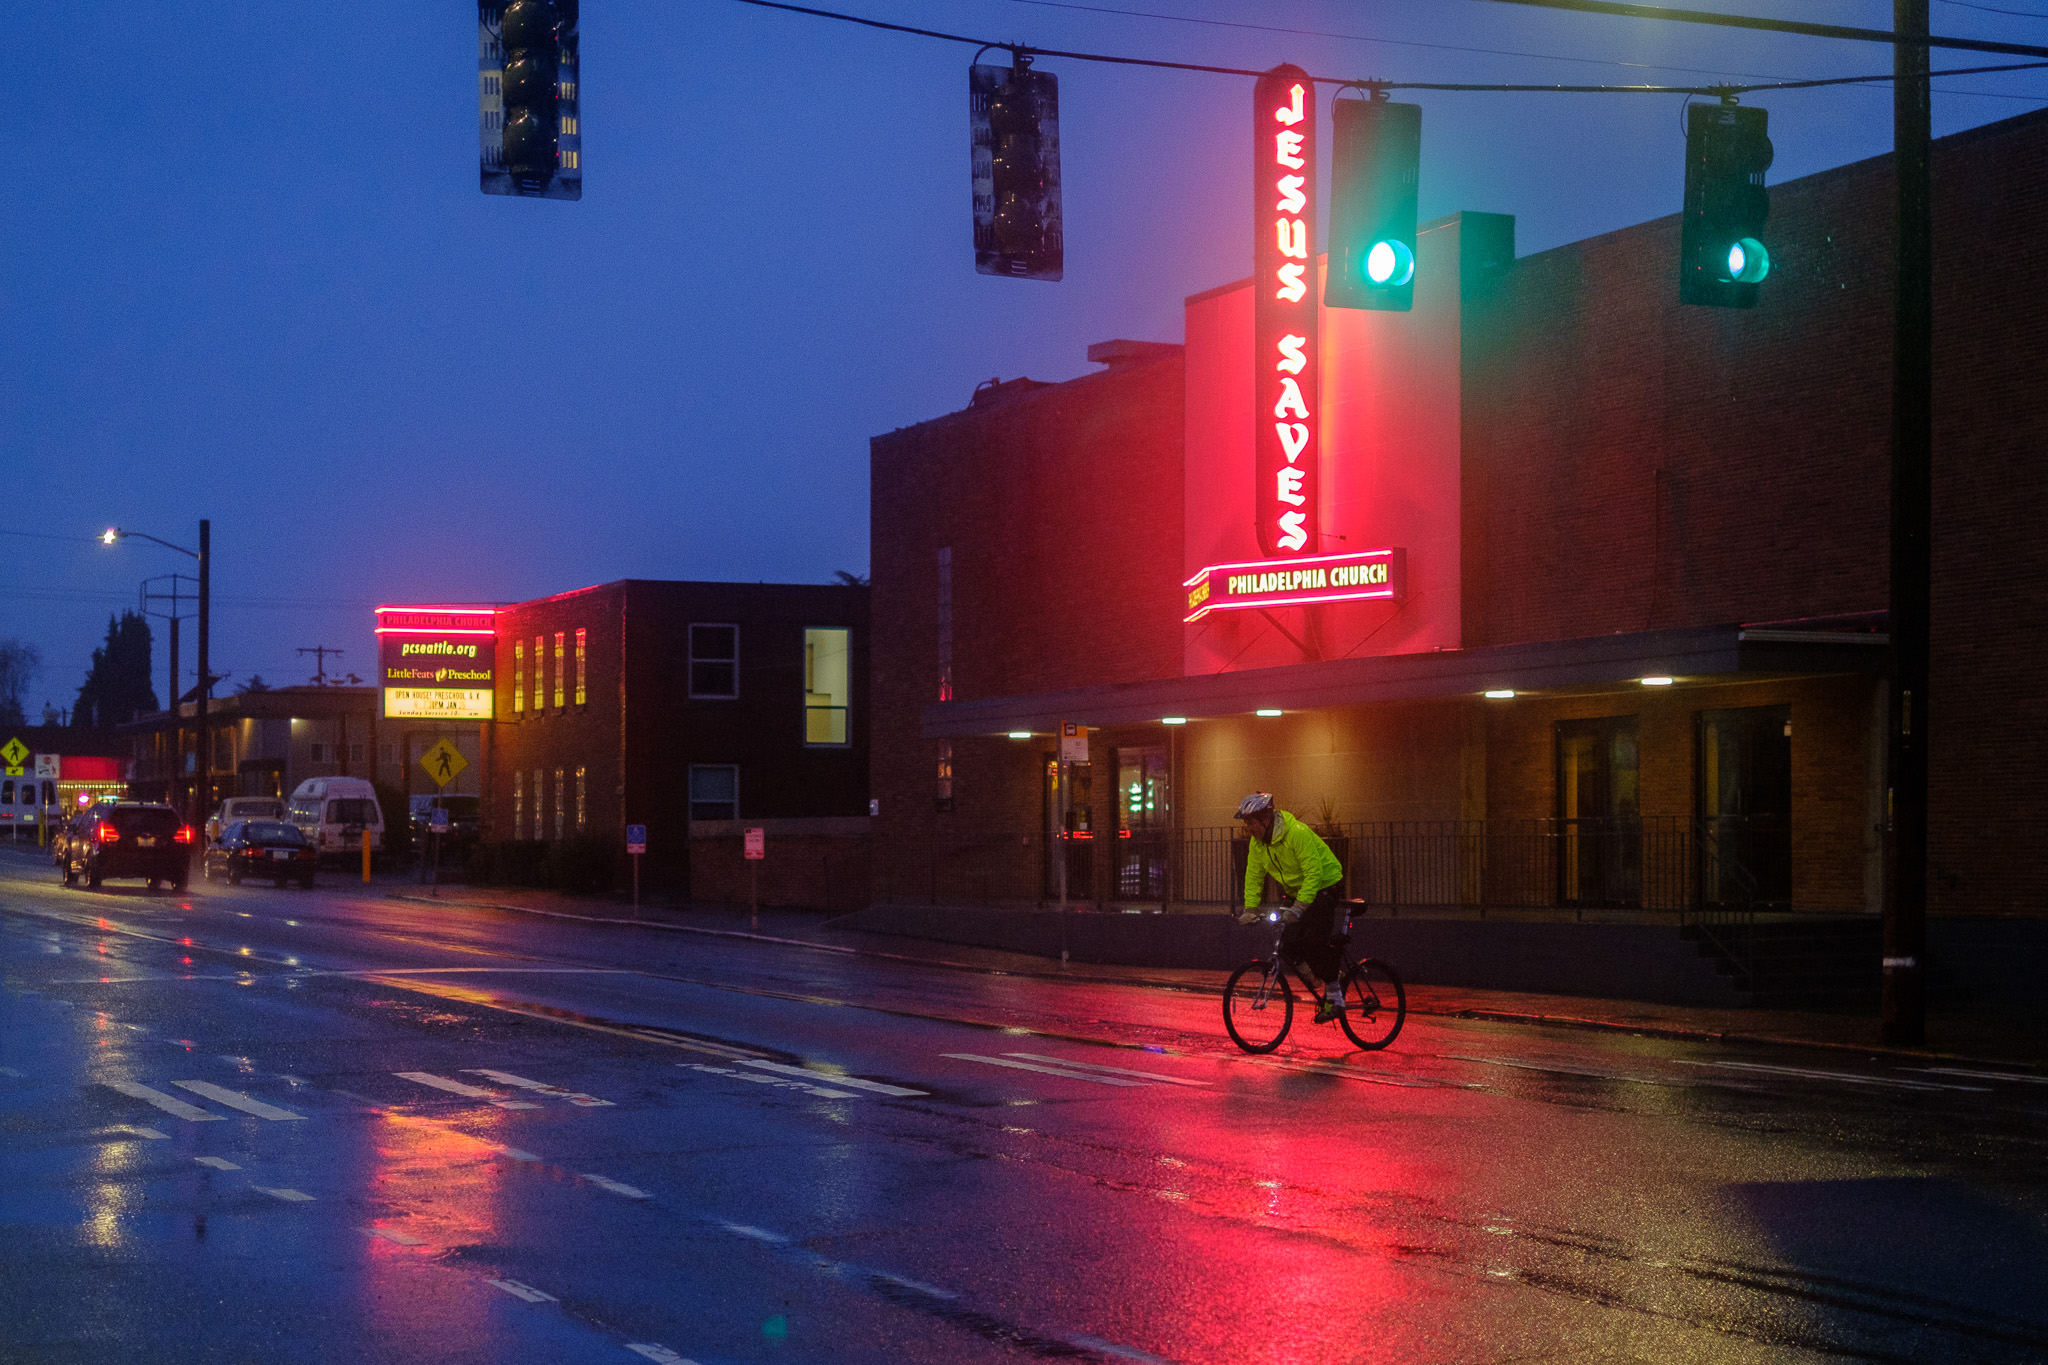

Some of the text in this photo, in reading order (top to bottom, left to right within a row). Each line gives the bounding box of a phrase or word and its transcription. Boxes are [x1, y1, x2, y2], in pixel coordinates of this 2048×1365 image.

[1274, 83, 1310, 551] JESUS SAVES
[1228, 563, 1388, 595] PHILADELPHIA CHURCH
[386, 615, 491, 627] PHILADELPHIA CHURCH
[401, 640, 478, 658] pcseattle.org
[447, 669, 491, 680] Preschool
[396, 691, 410, 699] OPEN
[434, 691, 466, 700] PRESCHOOL
